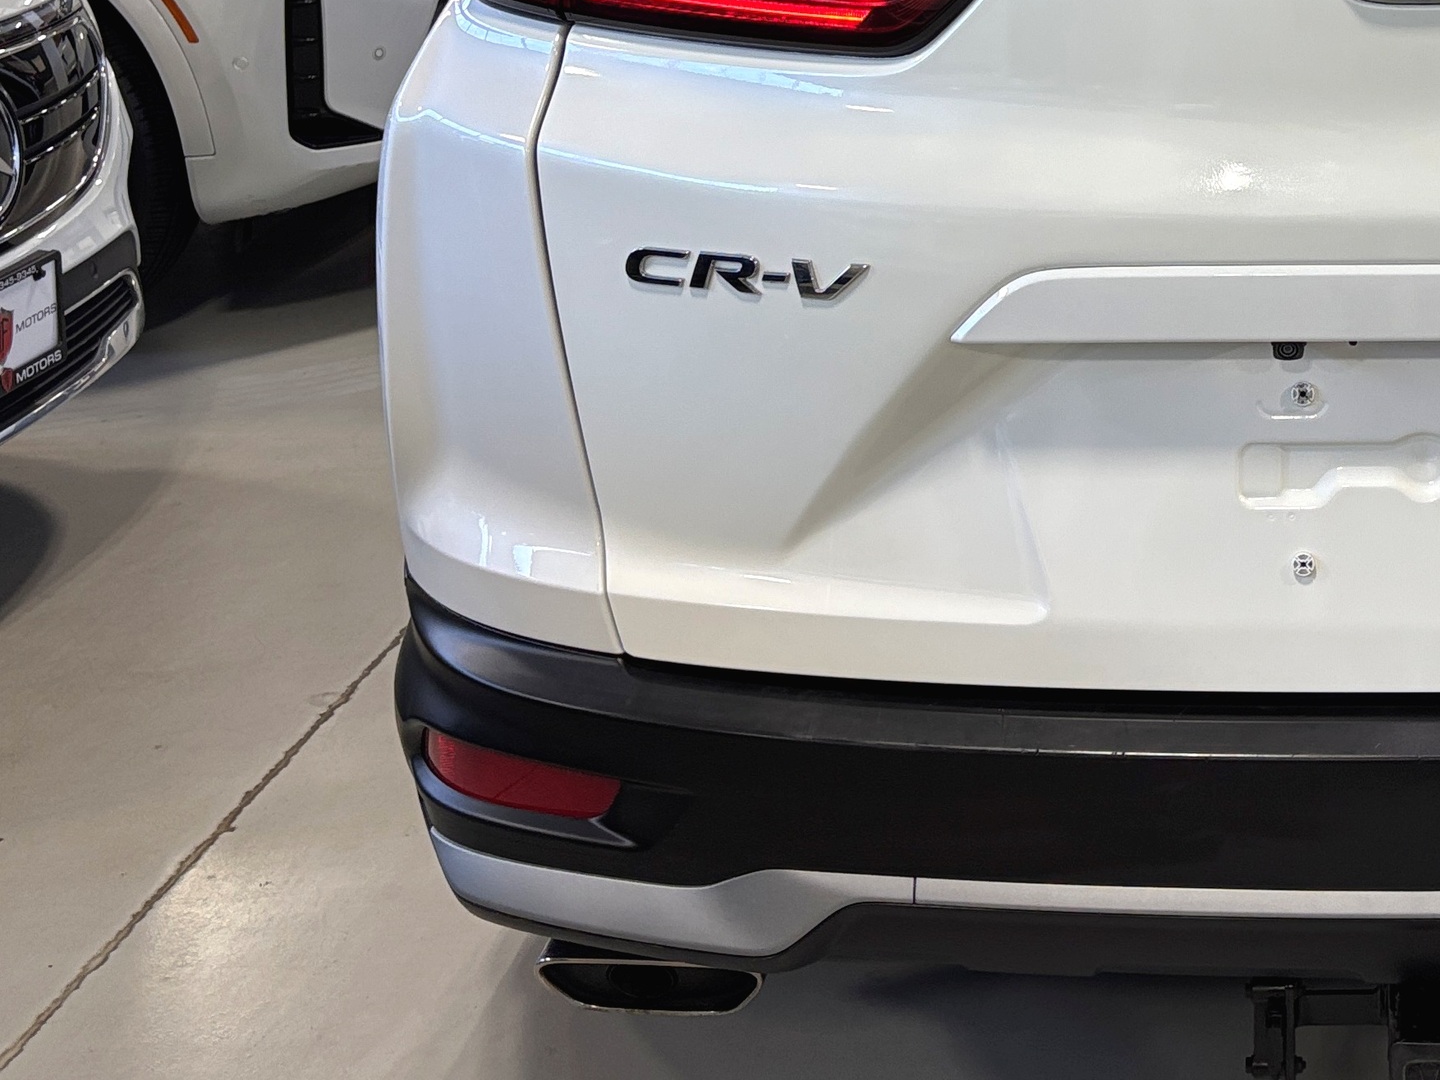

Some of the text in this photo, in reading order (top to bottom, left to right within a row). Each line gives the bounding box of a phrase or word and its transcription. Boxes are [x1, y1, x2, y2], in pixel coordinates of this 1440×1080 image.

[625, 246, 871, 301] CR-V
[15, 302, 57, 334] MOTORS
[16, 349, 62, 384] MOTORS
